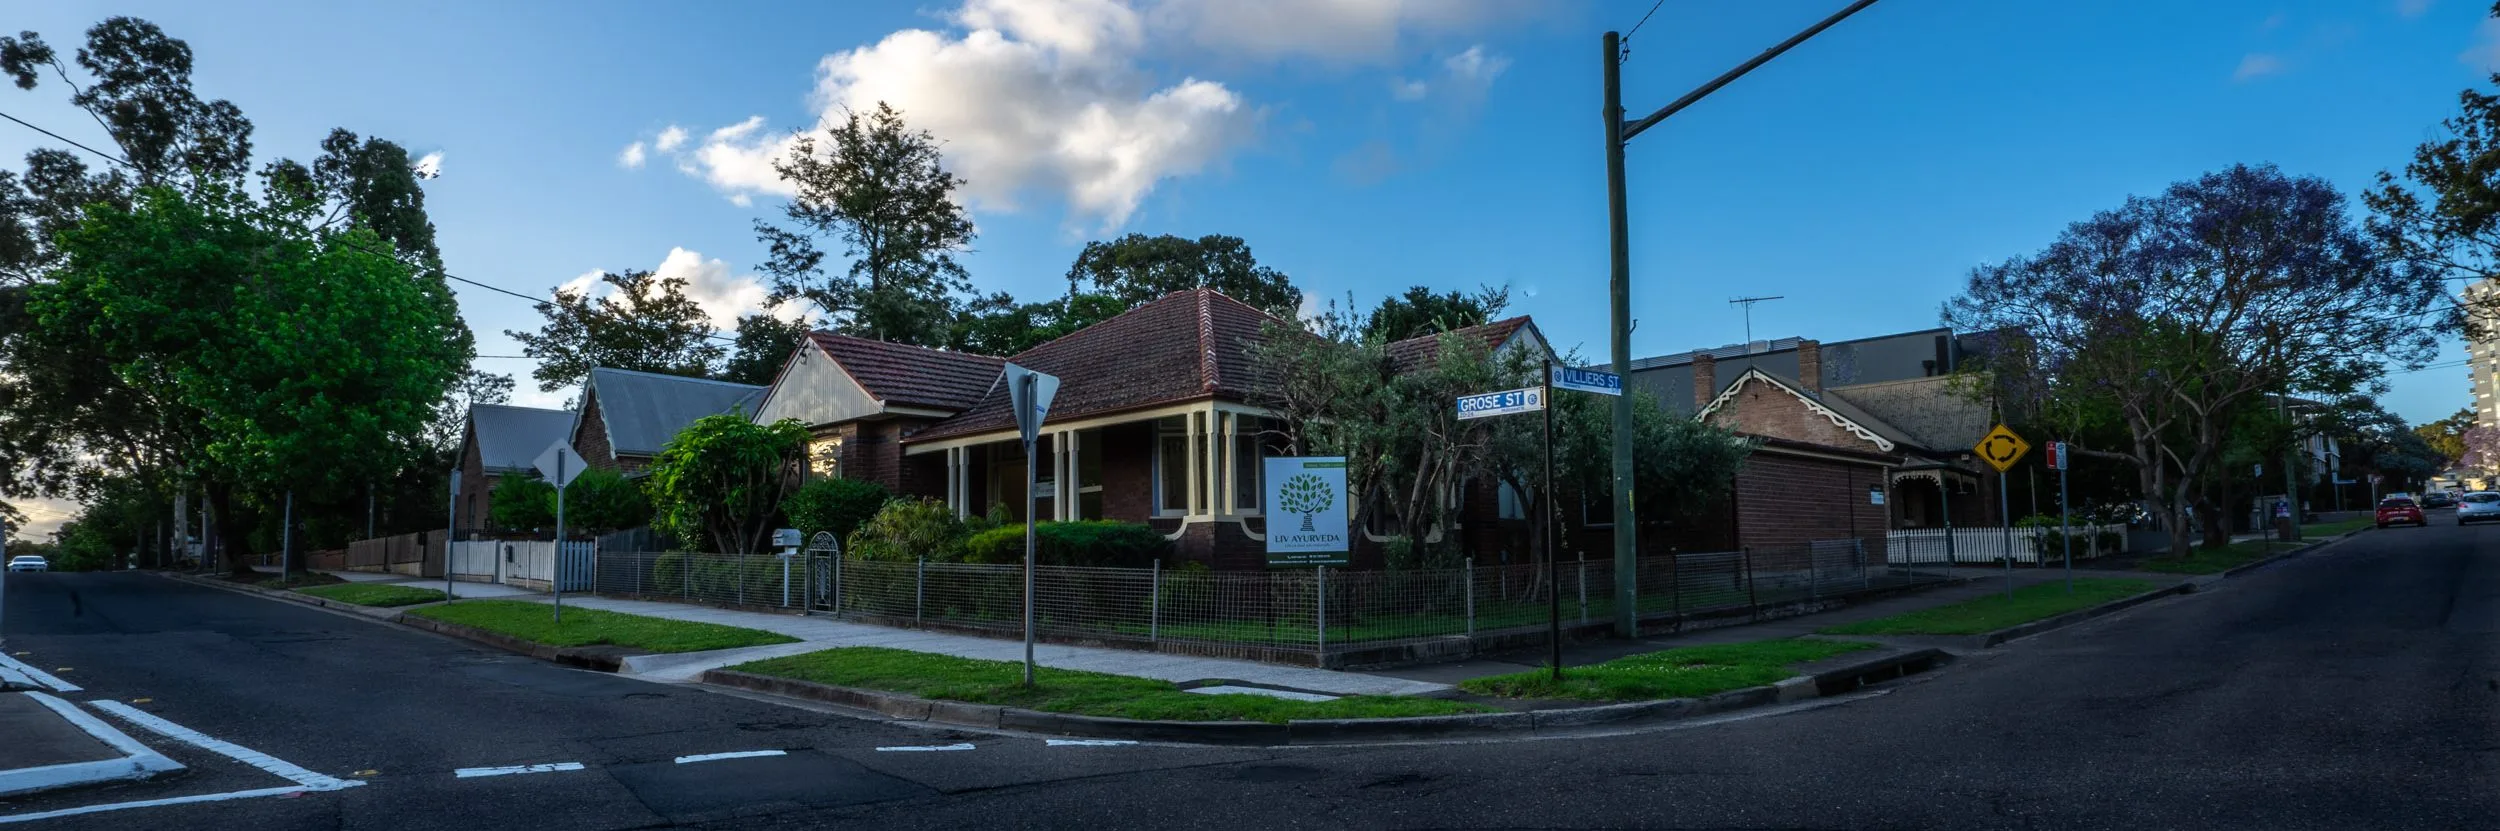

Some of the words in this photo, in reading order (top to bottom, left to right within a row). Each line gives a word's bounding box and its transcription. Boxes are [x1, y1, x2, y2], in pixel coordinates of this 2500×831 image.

[1565, 369, 1605, 386] VILLIERS
[1608, 375, 1619, 387] ST
[1461, 395, 1501, 411] GROSE
[1505, 392, 1522, 406] ST
[1275, 535, 1289, 543] LIV
[1291, 534, 1340, 543] AYURVEDA
